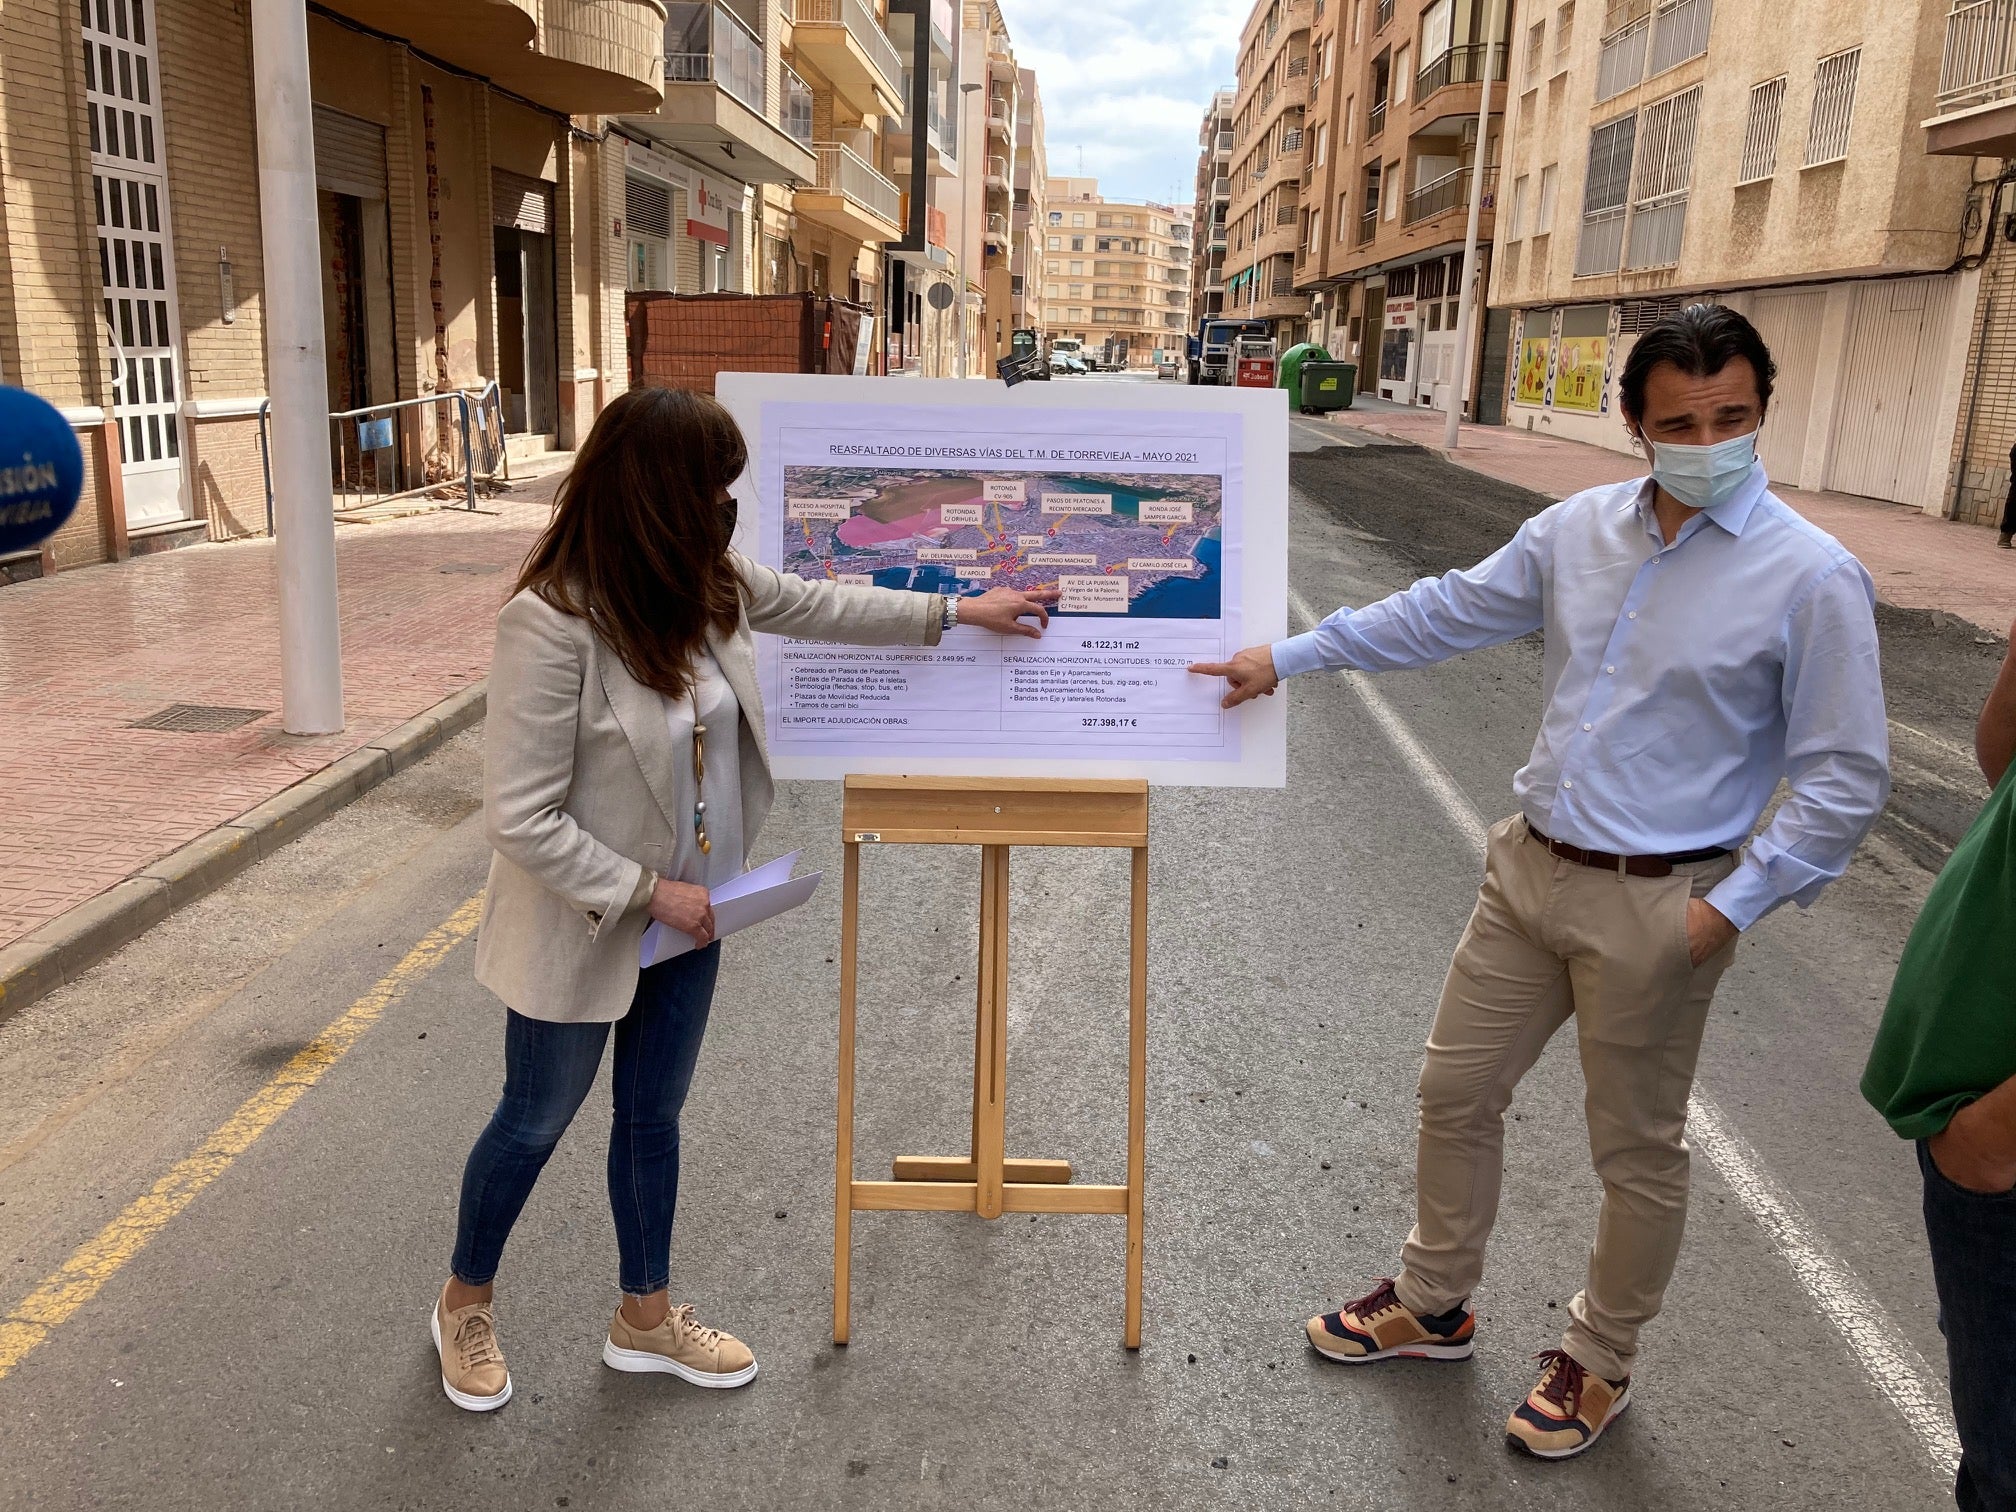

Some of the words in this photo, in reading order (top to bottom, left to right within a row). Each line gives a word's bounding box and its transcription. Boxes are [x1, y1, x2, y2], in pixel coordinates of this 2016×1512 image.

[830, 444, 904, 455] REASFALTADO
[908, 446, 922, 456] DE
[924, 446, 976, 457] DIVERSAS
[979, 446, 1002, 458] VÍAS
[1006, 449, 1024, 458] DEL
[1050, 450, 1064, 458] DE
[1068, 450, 1132, 460] TORREVIEJA
[1142, 452, 1172, 461] MAYO
[1174, 452, 1198, 462] 2021
[1081, 640, 1123, 650] 48.122,31
[1126, 641, 1140, 649] m2
[784, 652, 836, 660] SEÑALIZACIÓN
[1004, 656, 1055, 664] SEÑALIZACIÓN
[1082, 718, 1129, 728] 327.398,17
[1131, 719, 1137, 727] €
